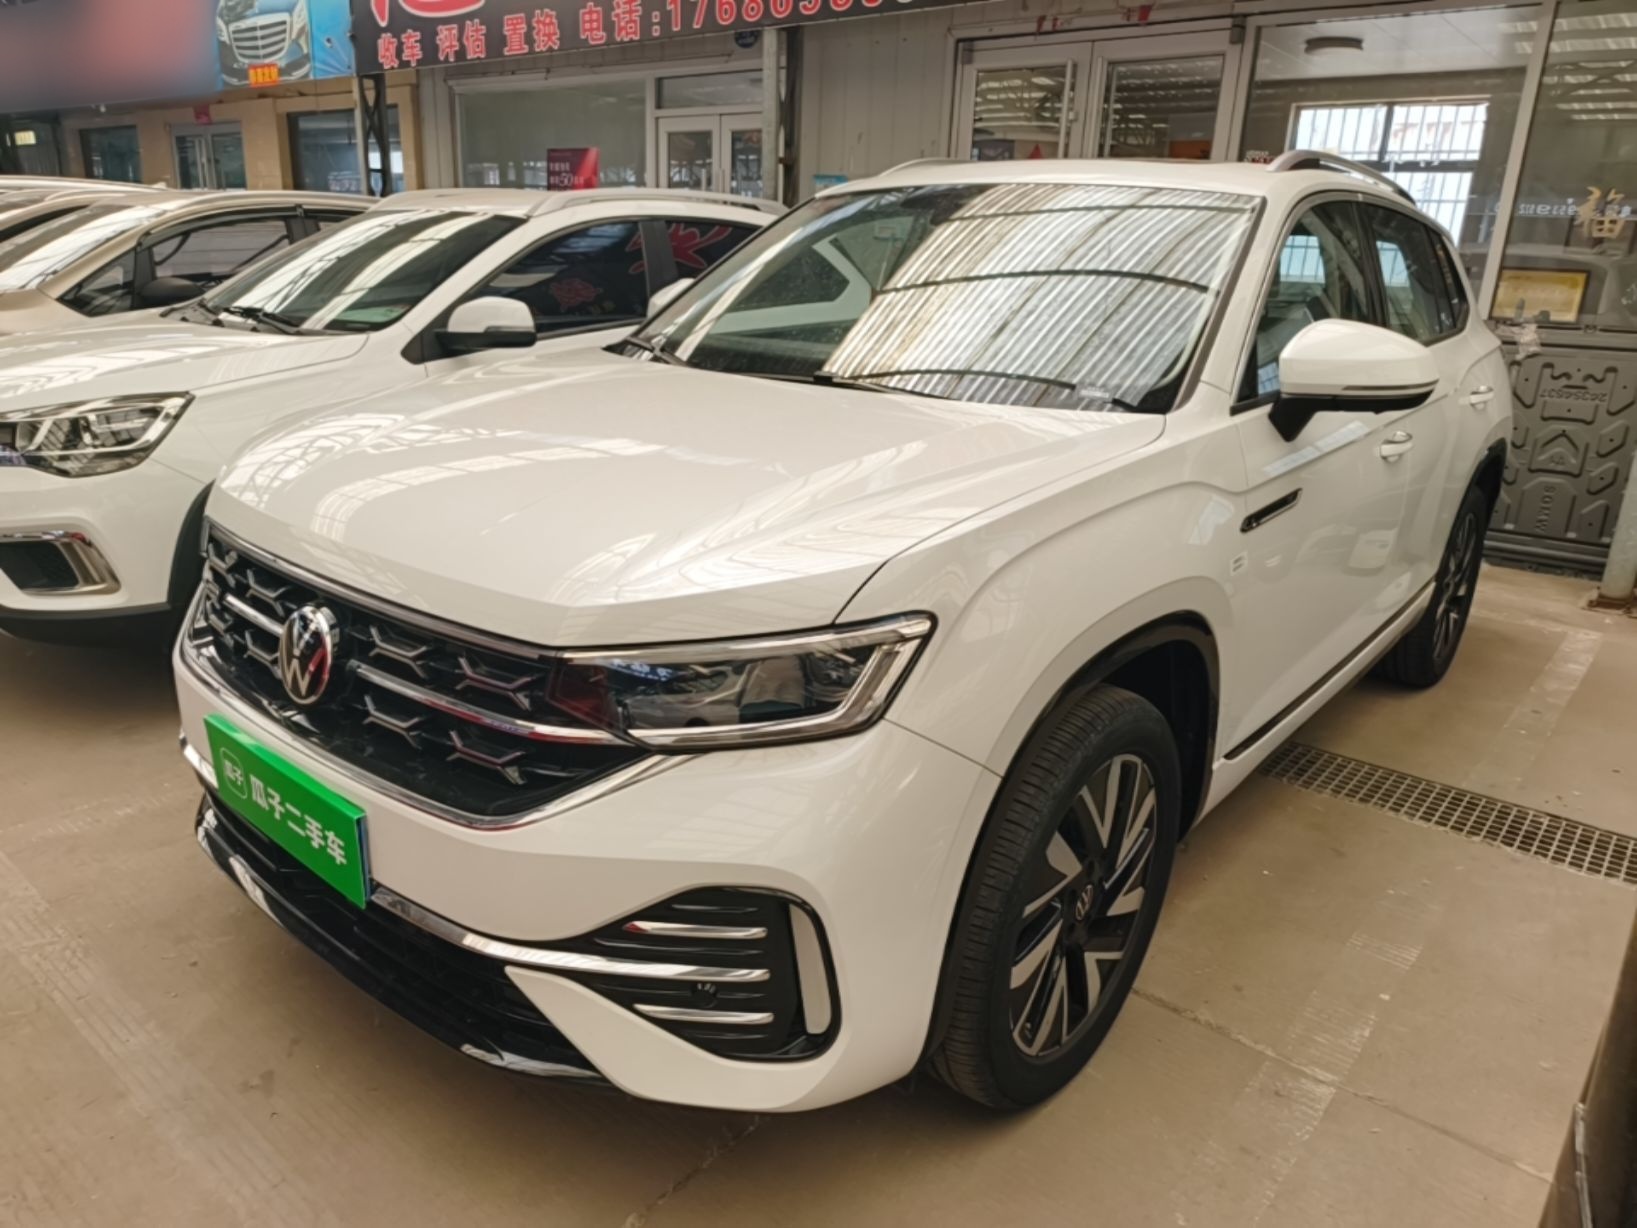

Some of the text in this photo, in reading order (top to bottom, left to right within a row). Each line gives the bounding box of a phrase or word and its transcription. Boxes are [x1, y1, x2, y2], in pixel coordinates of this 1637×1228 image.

[377, 28, 423, 70] 收车
[436, 19, 487, 62] 评估
[503, 9, 560, 56] 置换
[249, 773, 348, 865] 瓜子二手车
